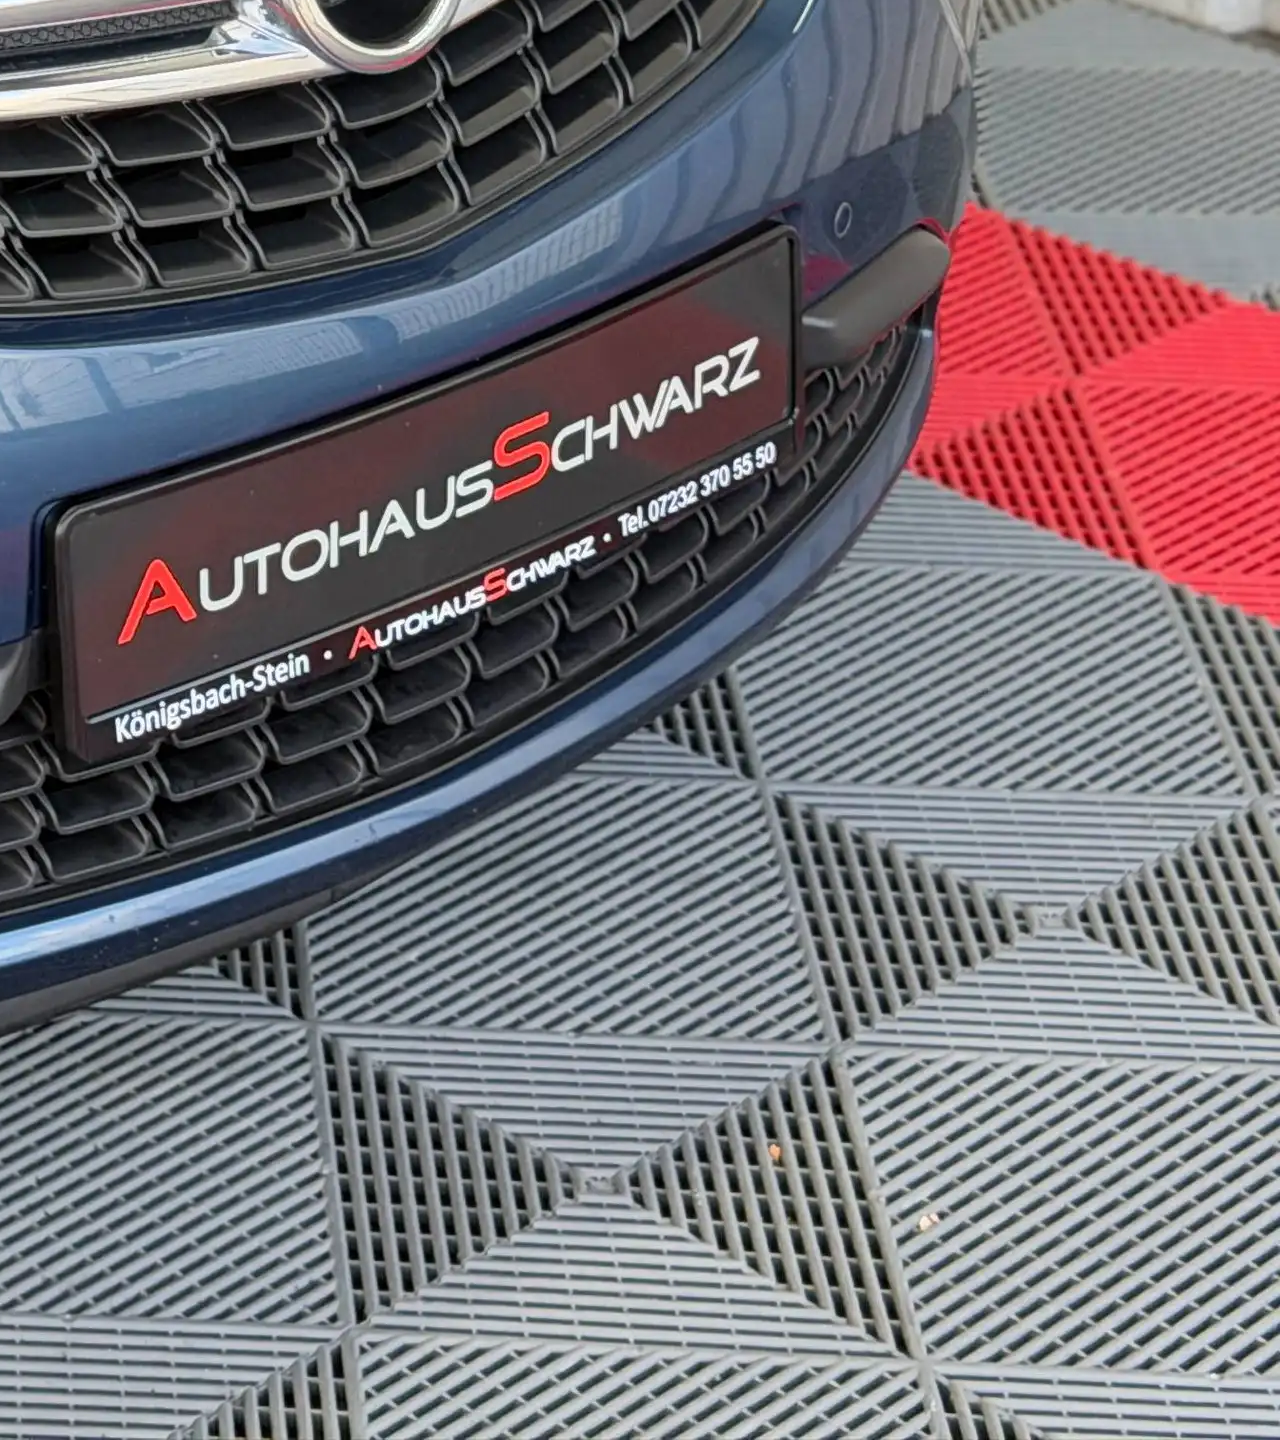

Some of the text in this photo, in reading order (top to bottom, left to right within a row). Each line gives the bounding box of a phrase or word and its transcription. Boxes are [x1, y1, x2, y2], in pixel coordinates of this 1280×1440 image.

[114, 652, 310, 743] Königsbach-Stein
[647, 480, 700, 523] 07232
[700, 464, 731, 497] 370
[732, 452, 754, 481] 55
[755, 441, 778, 470] 50
